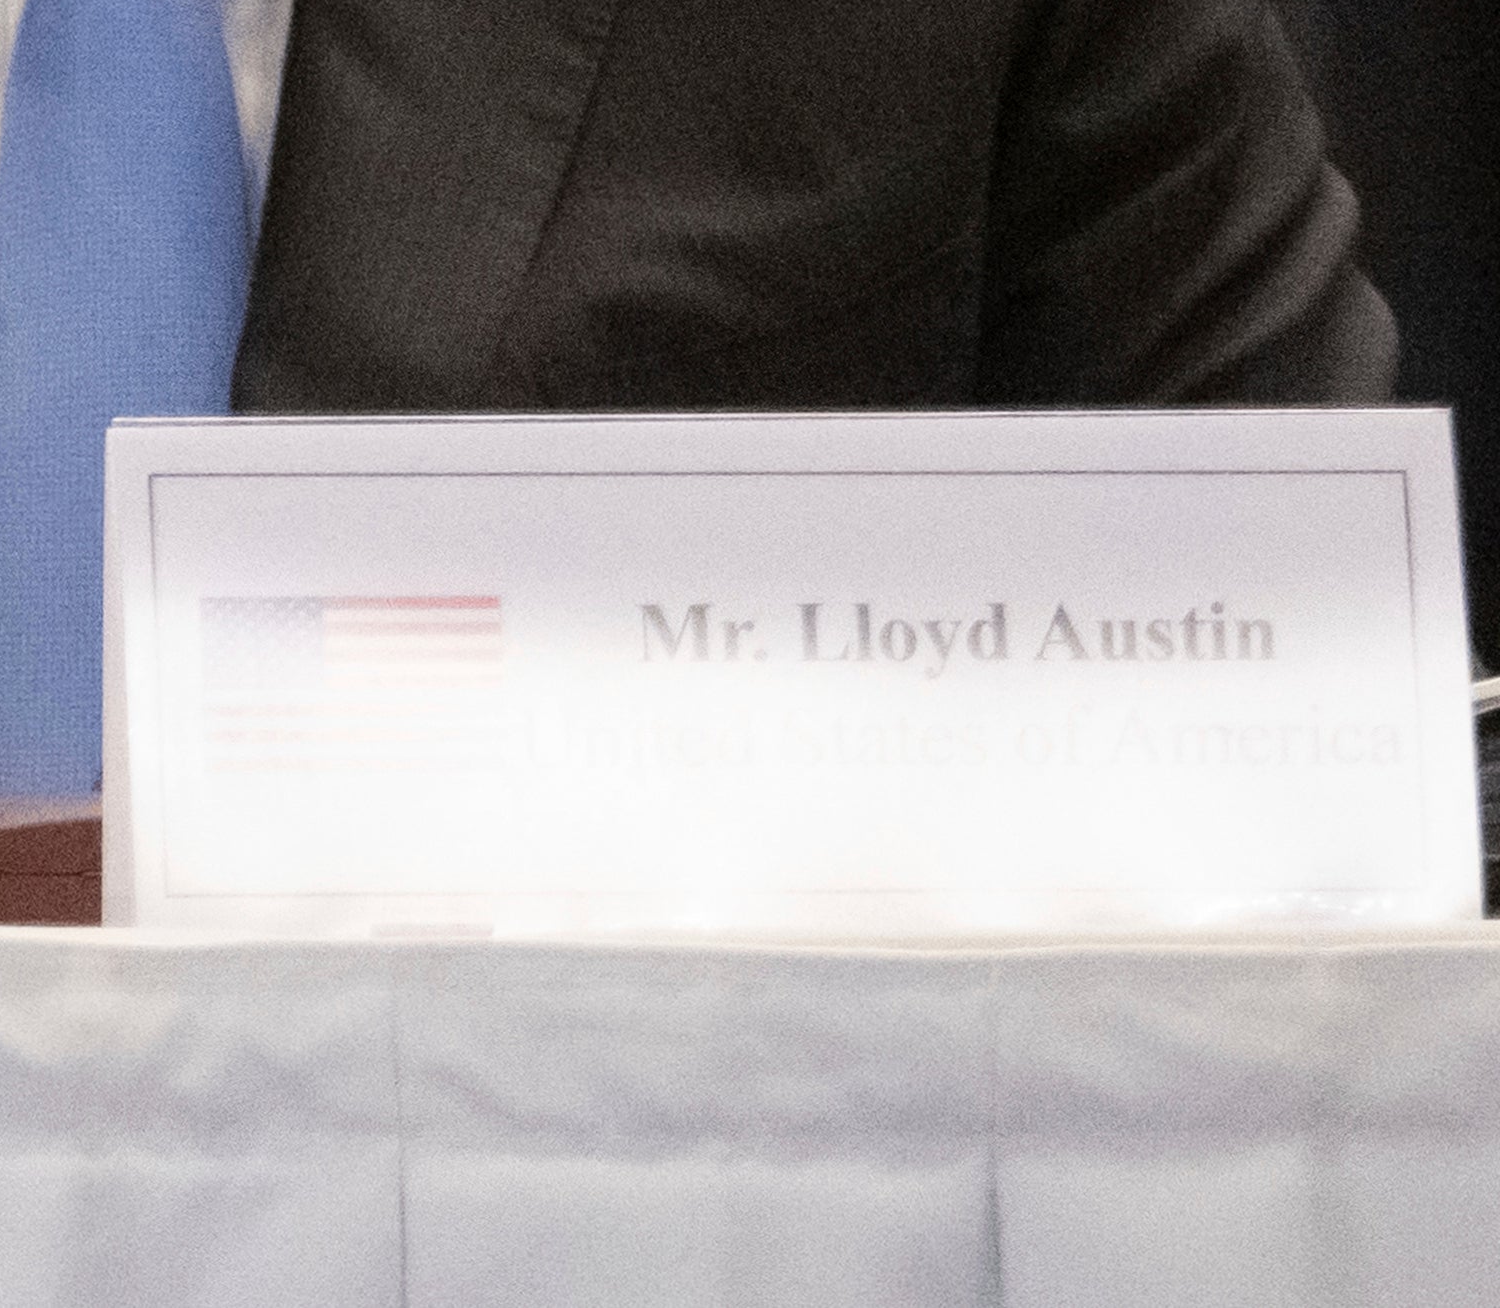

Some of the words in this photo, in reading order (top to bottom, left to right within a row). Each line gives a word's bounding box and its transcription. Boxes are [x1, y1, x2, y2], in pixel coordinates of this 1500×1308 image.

[639, 600, 770, 663] Mr.
[797, 600, 1011, 680] Lloyd
[1033, 600, 1278, 663] Austin
[523, 706, 755, 770] United
[792, 706, 988, 770] States
[1014, 705, 1092, 770] of
[1110, 704, 1404, 770] America
